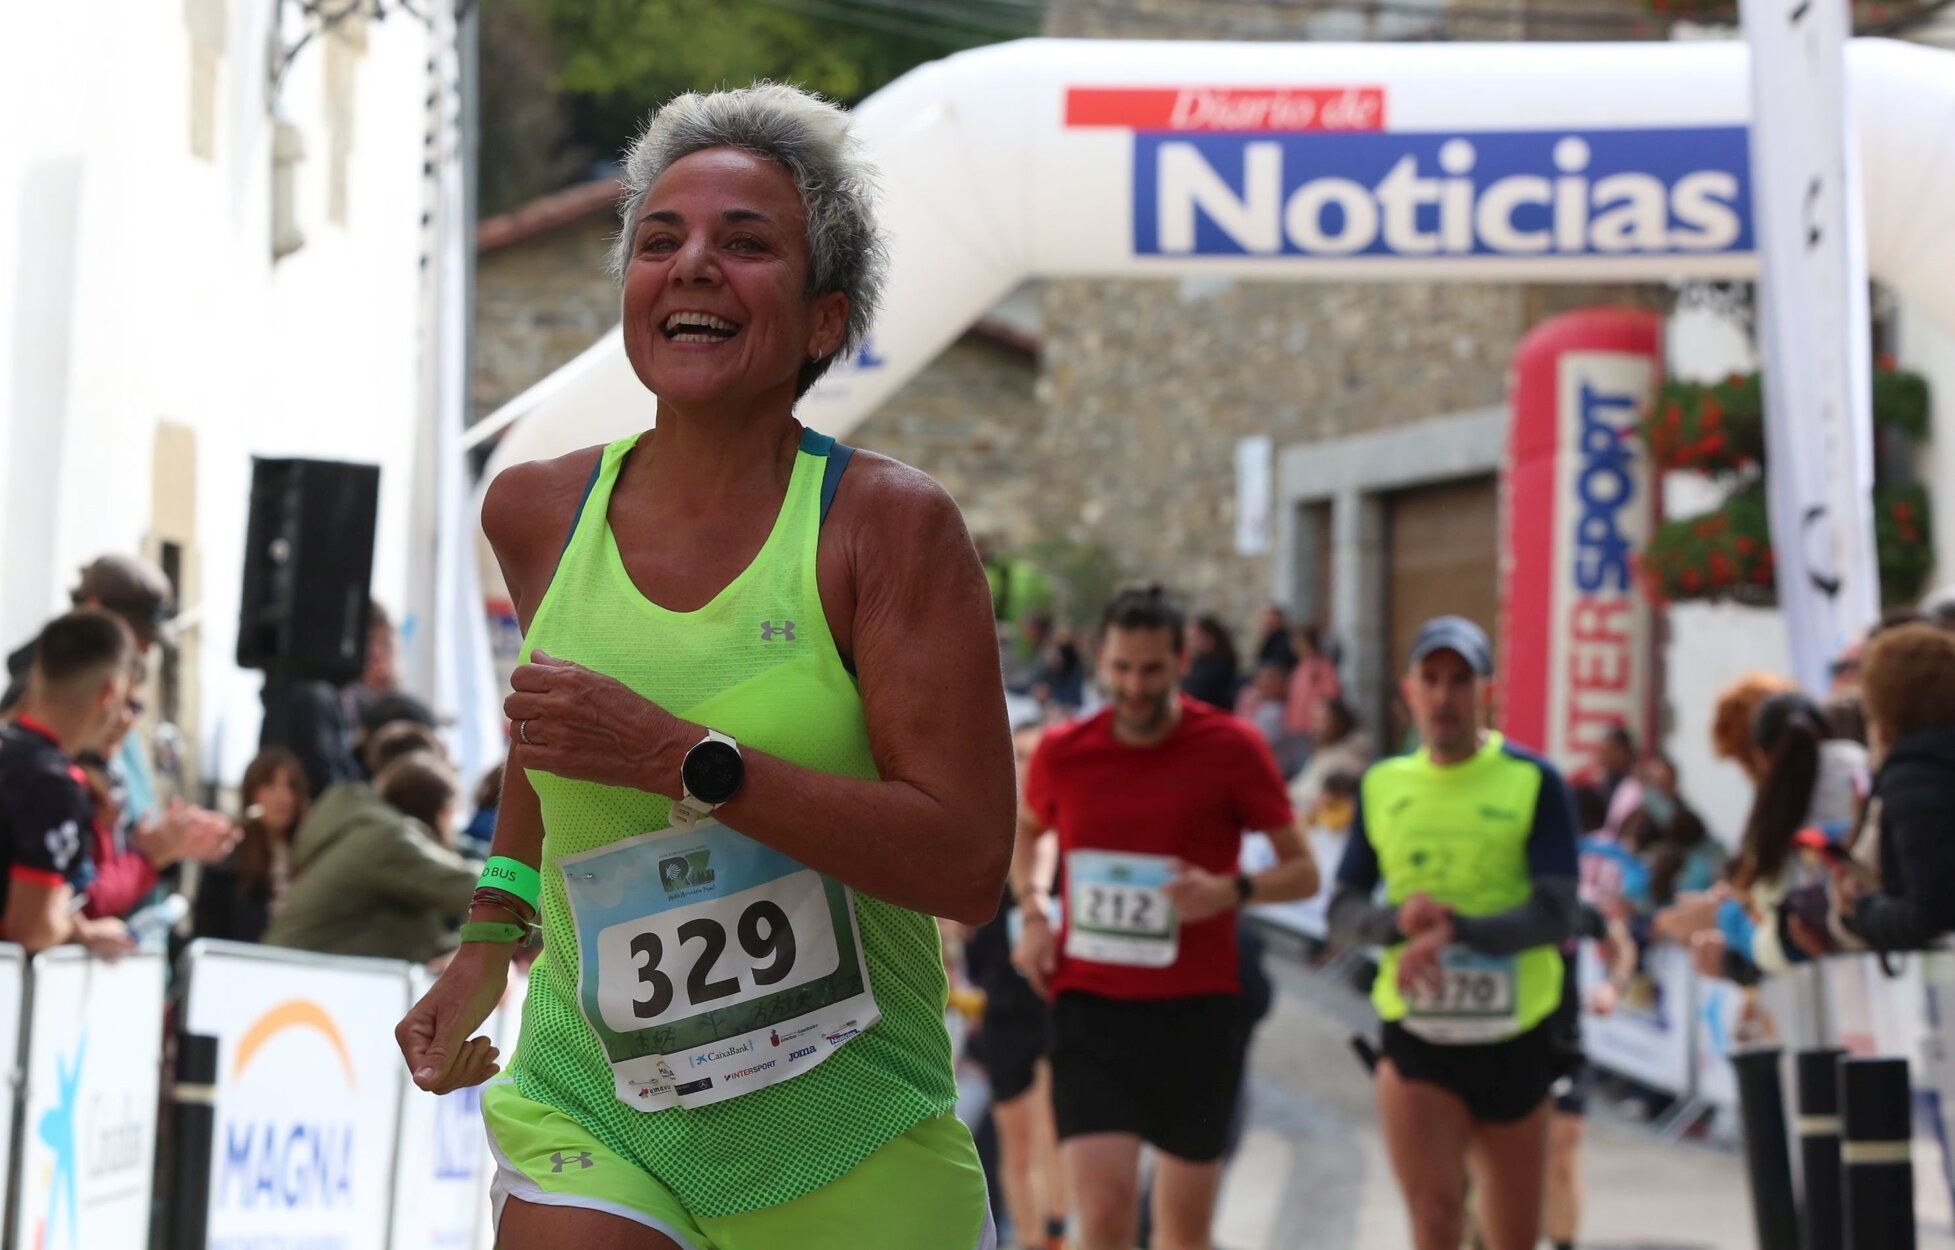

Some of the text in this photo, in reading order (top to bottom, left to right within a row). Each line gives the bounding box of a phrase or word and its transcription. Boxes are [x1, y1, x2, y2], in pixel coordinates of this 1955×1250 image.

[1171, 87, 1380, 131] Diario de
[1156, 137, 1740, 254] Noticias
[1564, 381, 1640, 790] NTERSPORT
[491, 867, 516, 881] BUS
[1086, 886, 1153, 926] 212
[629, 899, 797, 1019] 329
[707, 1044, 749, 1061] CaixaBank
[731, 1060, 776, 1079] INTERSPORT
[221, 1121, 353, 1208] MAGNA
